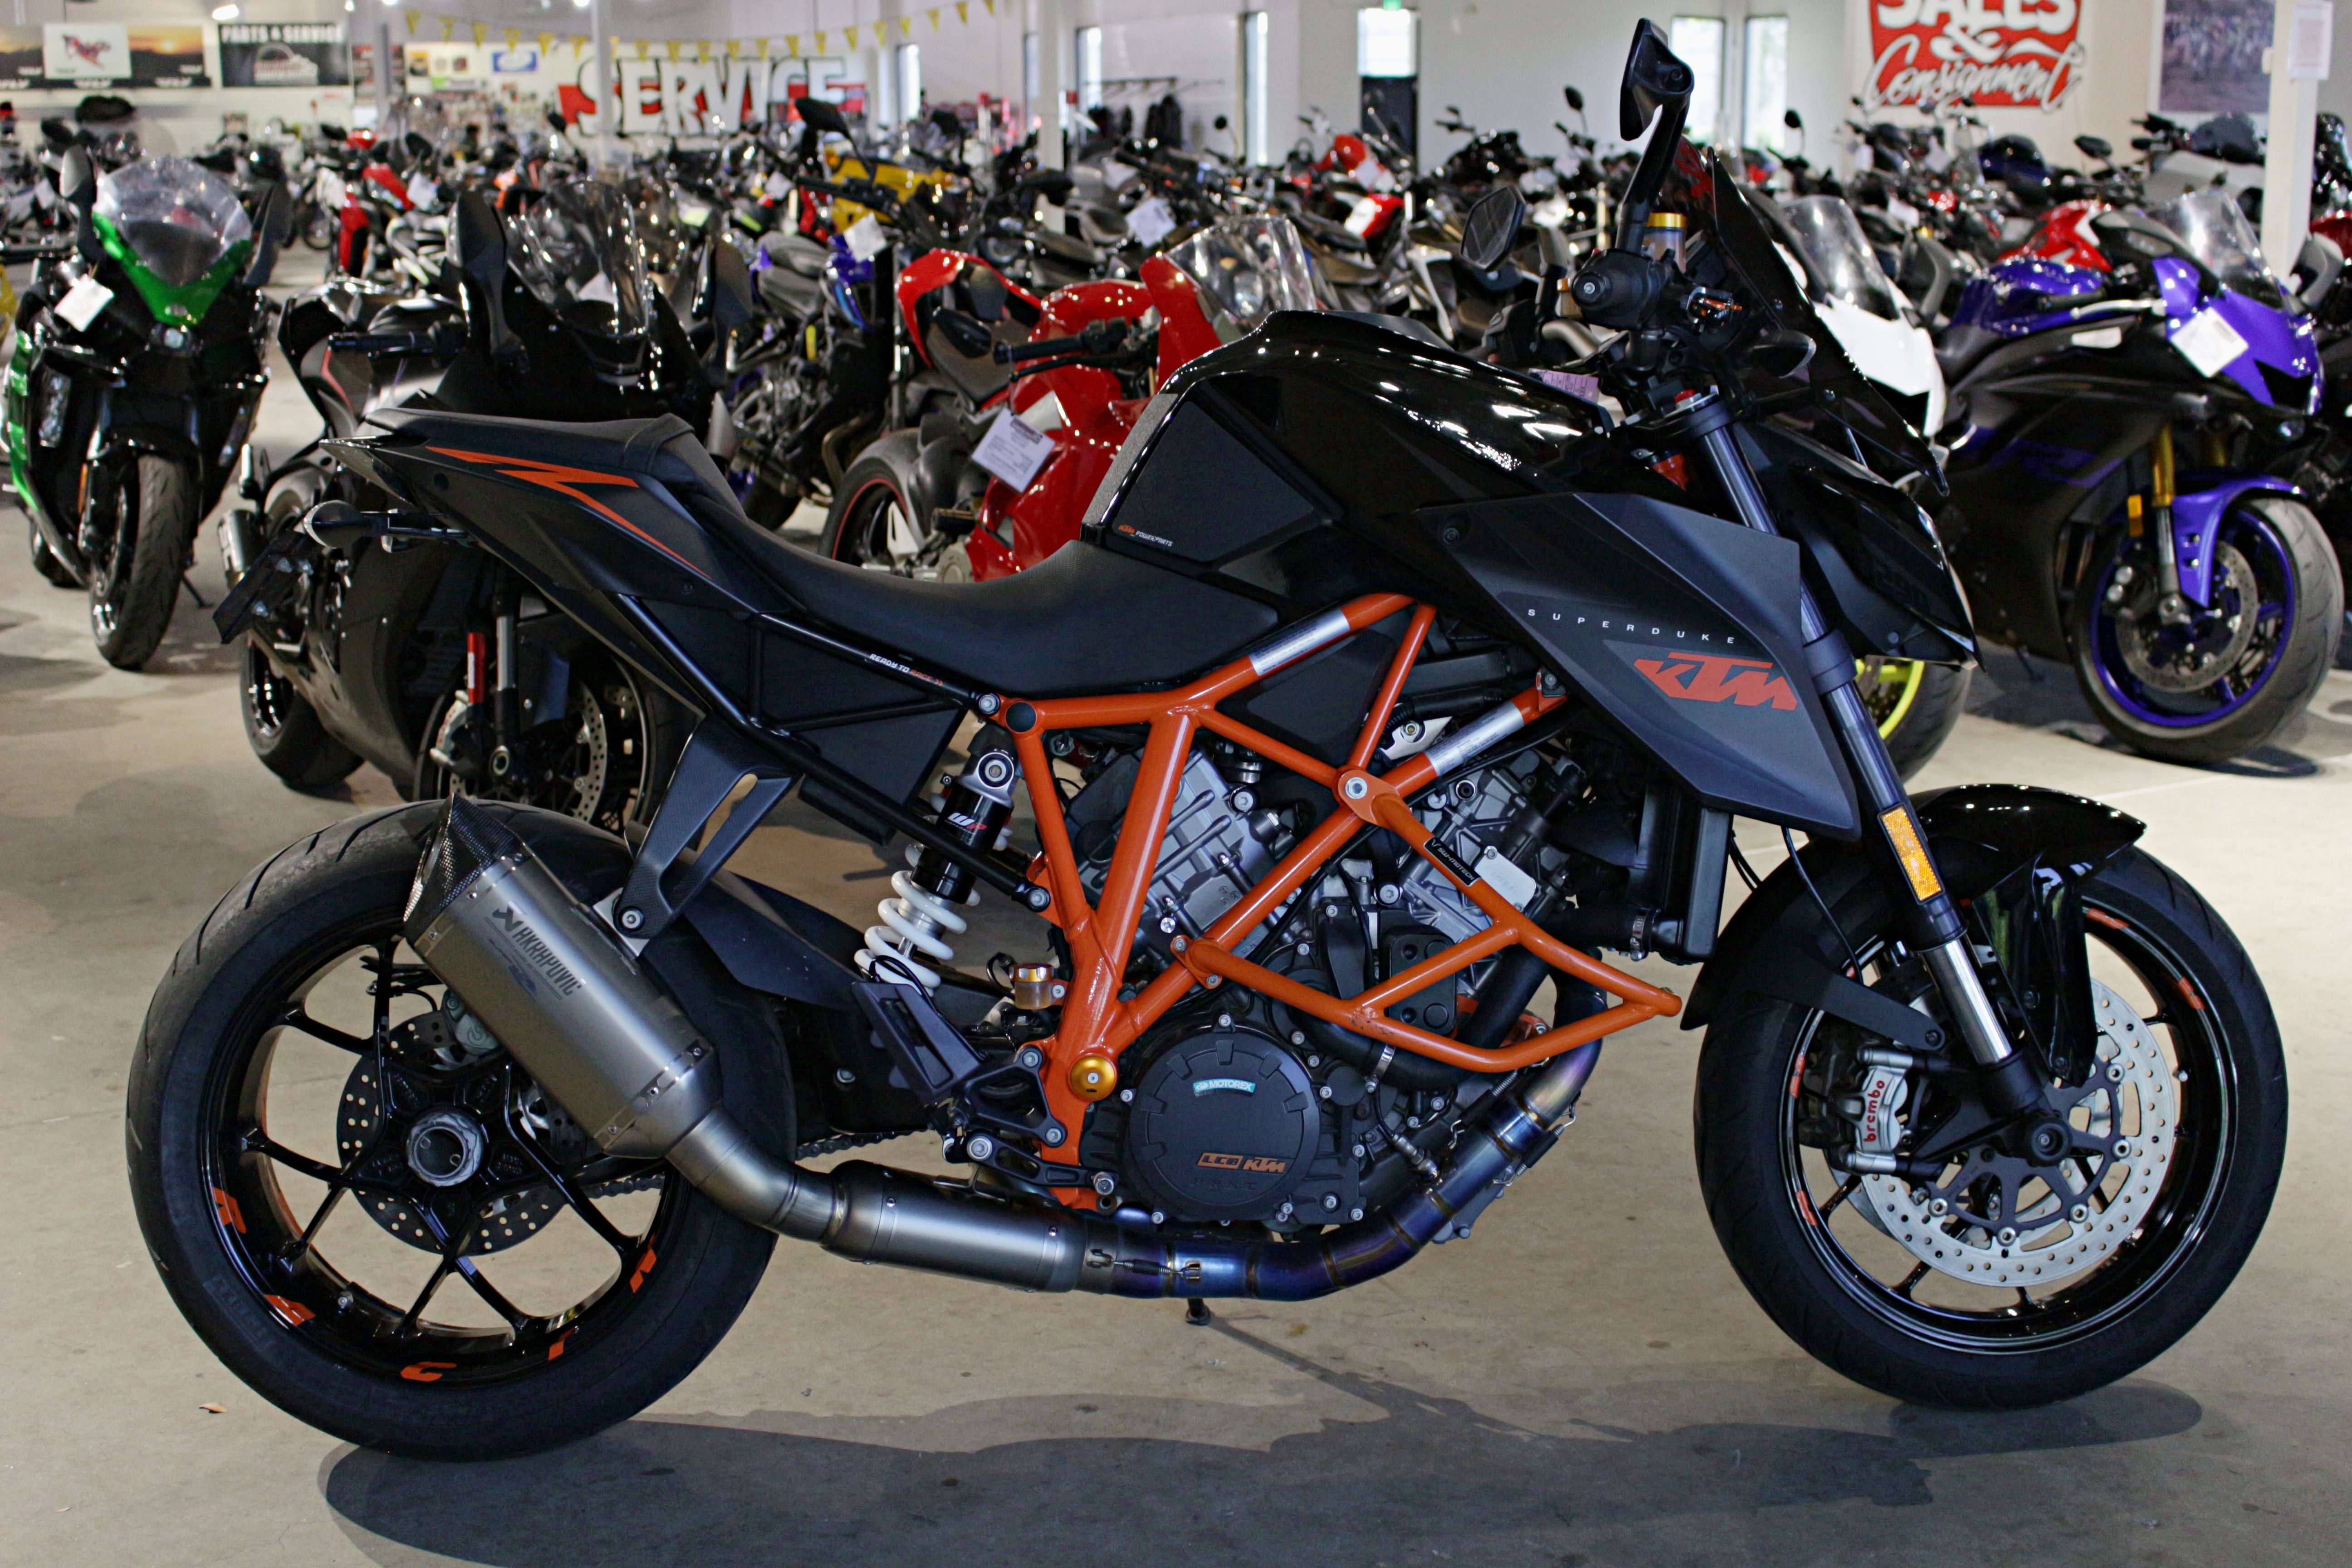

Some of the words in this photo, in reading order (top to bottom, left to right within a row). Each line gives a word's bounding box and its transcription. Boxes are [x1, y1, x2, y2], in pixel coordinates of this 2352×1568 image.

[221, 24, 269, 44] PARTS
[1862, 34, 2085, 119] Consignment
[577, 56, 847, 137] SERVICE
[869, 653, 898, 669] READY
[898, 664, 910, 673] TO
[1633, 652, 1798, 711] KTM
[1437, 847, 1475, 881] SW-MOTECH
[1209, 1079, 1253, 1091] MOTOREX
[1863, 1080, 1885, 1142] brembo
[1242, 1156, 1286, 1174] KTM
